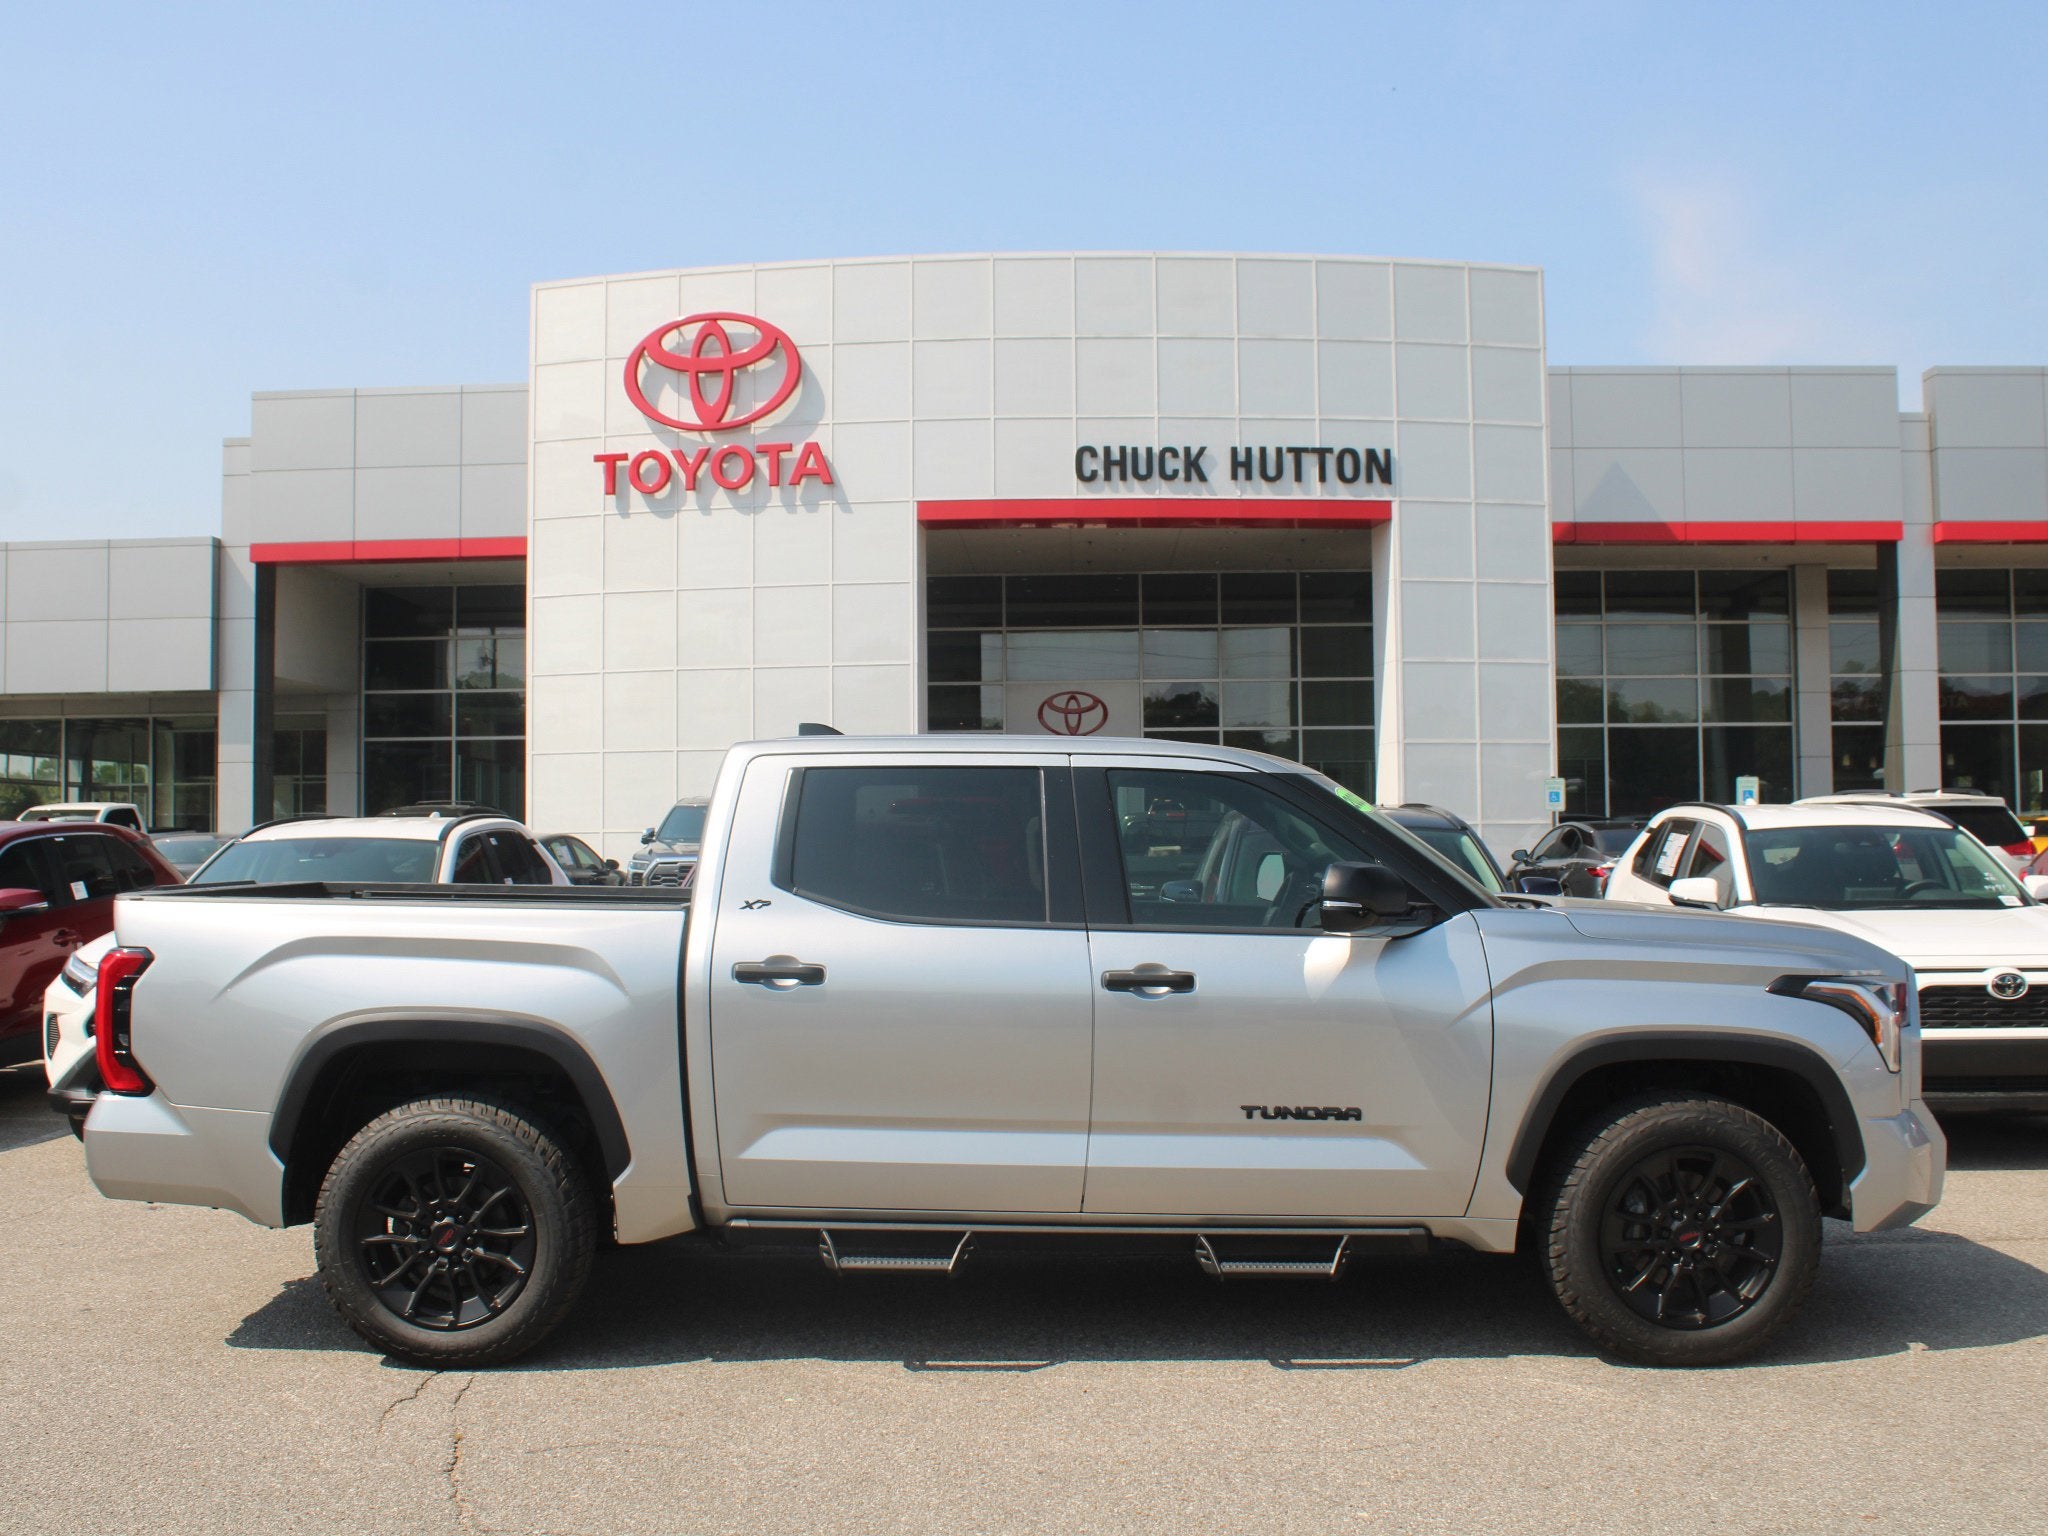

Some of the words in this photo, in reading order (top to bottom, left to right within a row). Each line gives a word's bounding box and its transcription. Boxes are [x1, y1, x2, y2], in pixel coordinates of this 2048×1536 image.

[594, 441, 834, 495] TOYOTA
[1075, 445, 1208, 483] CHUCK
[1230, 446, 1393, 485] HUTTON
[1240, 1105, 1362, 1121] TUNDRA
